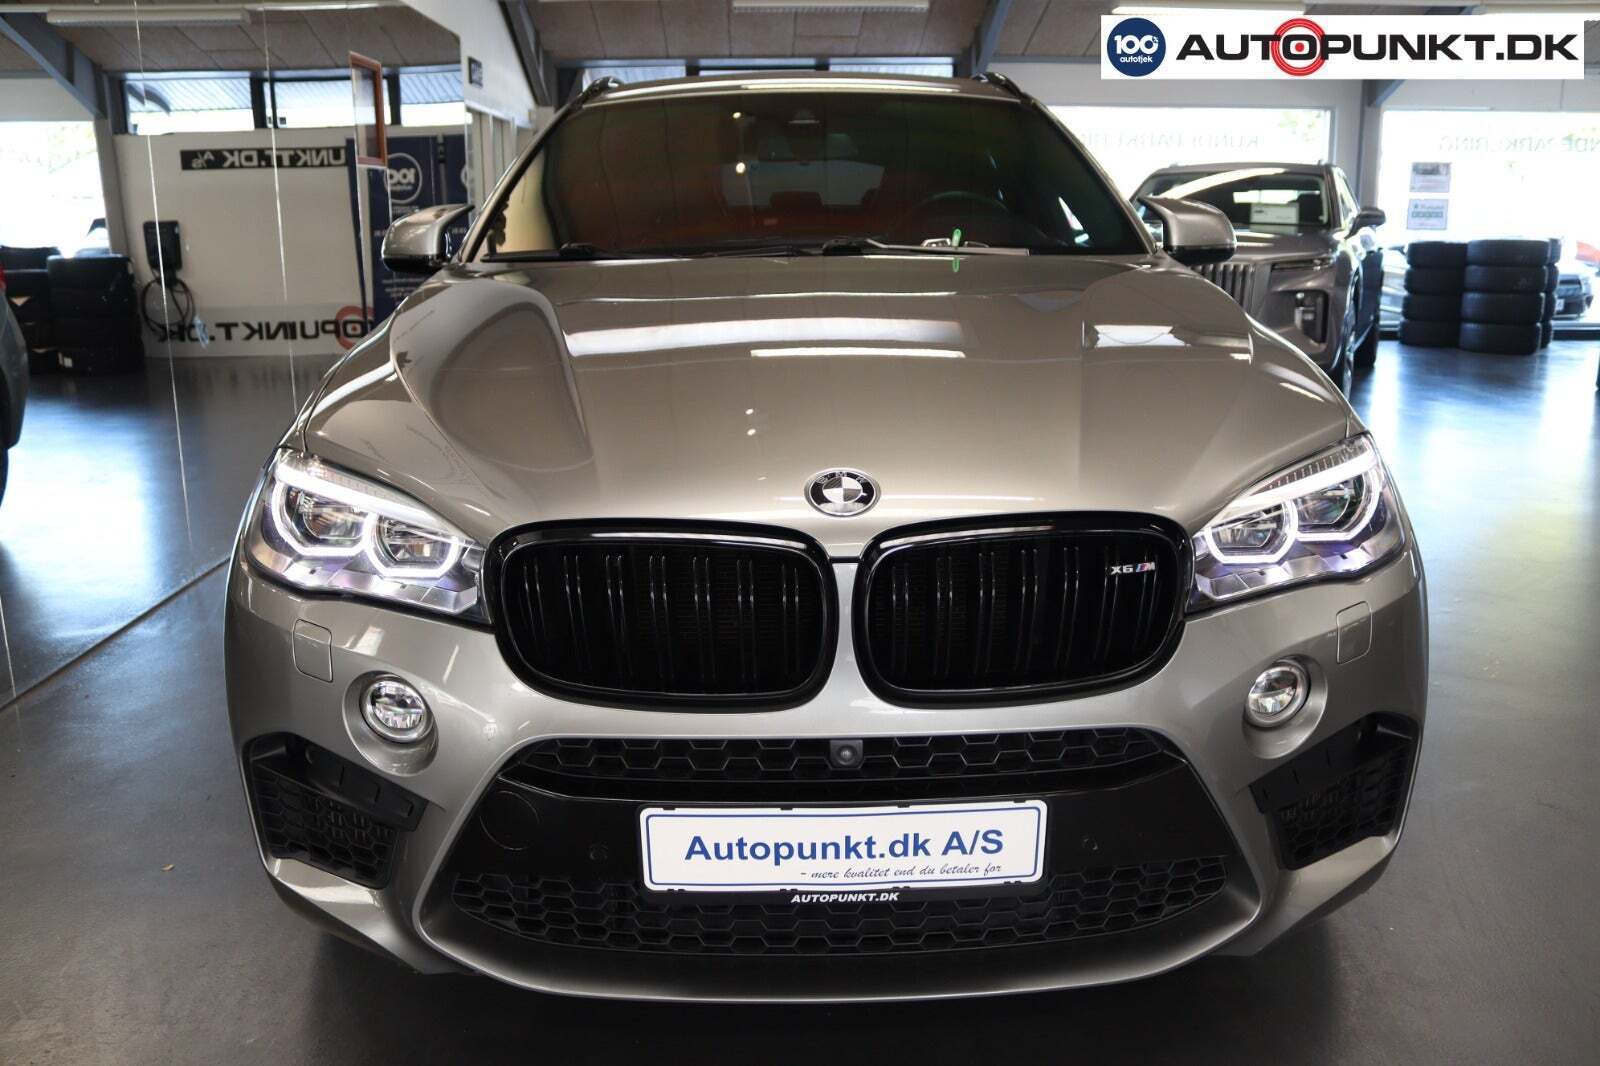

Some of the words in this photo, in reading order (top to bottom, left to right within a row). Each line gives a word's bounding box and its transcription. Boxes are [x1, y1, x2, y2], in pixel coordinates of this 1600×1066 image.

[685, 833, 931, 866] Autopunkt.dk
[941, 829, 1003, 856] A/S
[811, 871, 839, 879] mere
[844, 867, 890, 879] kvalitet
[894, 866, 916, 877] end
[920, 865, 935, 876] du
[940, 863, 979, 875] betaler
[983, 862, 1002, 876] for
[791, 892, 900, 904] AUTOPUNKT.DK
